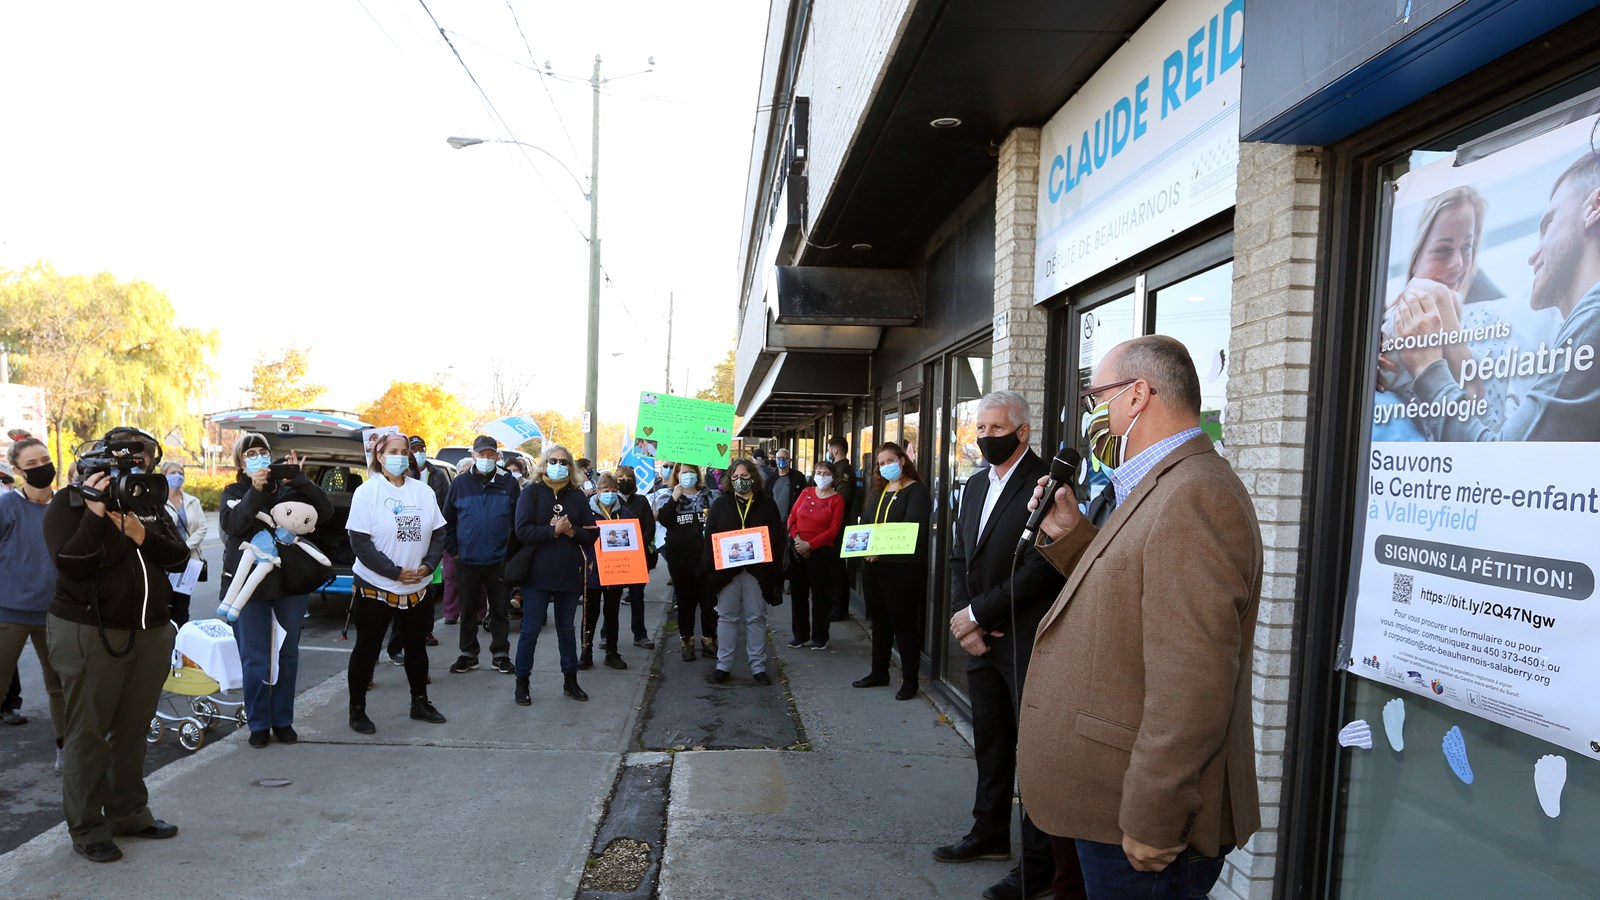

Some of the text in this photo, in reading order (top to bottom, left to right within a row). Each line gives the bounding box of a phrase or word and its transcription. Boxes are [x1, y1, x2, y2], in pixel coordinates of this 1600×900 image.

[1048, 0, 1244, 204] CLAUDE REID
[1046, 181, 1180, 277] DÉPUTÉ DE BEAUHARNOIS
[1459, 338, 1595, 390] pédiatrie
[1374, 393, 1488, 424] gynécologie
[1371, 449, 1453, 474] Sauvons
[1369, 499, 1478, 532] à Valleyfield
[1370, 476, 1599, 514] le Centre mère-enfant
[1384, 543, 1573, 591] SIGNONS LA PÉTITION!
[1394, 608, 1542, 654] Pour vous procurer un formulaire ou pour
[1420, 587, 1555, 629] https://bit.ly/2Q47Ngw
[1380, 618, 1560, 673] vous impliquer, communiquez au 450 373-4504 ou
[1383, 629, 1551, 687] à corporation@cdc-beauharnois-salaberry.org
